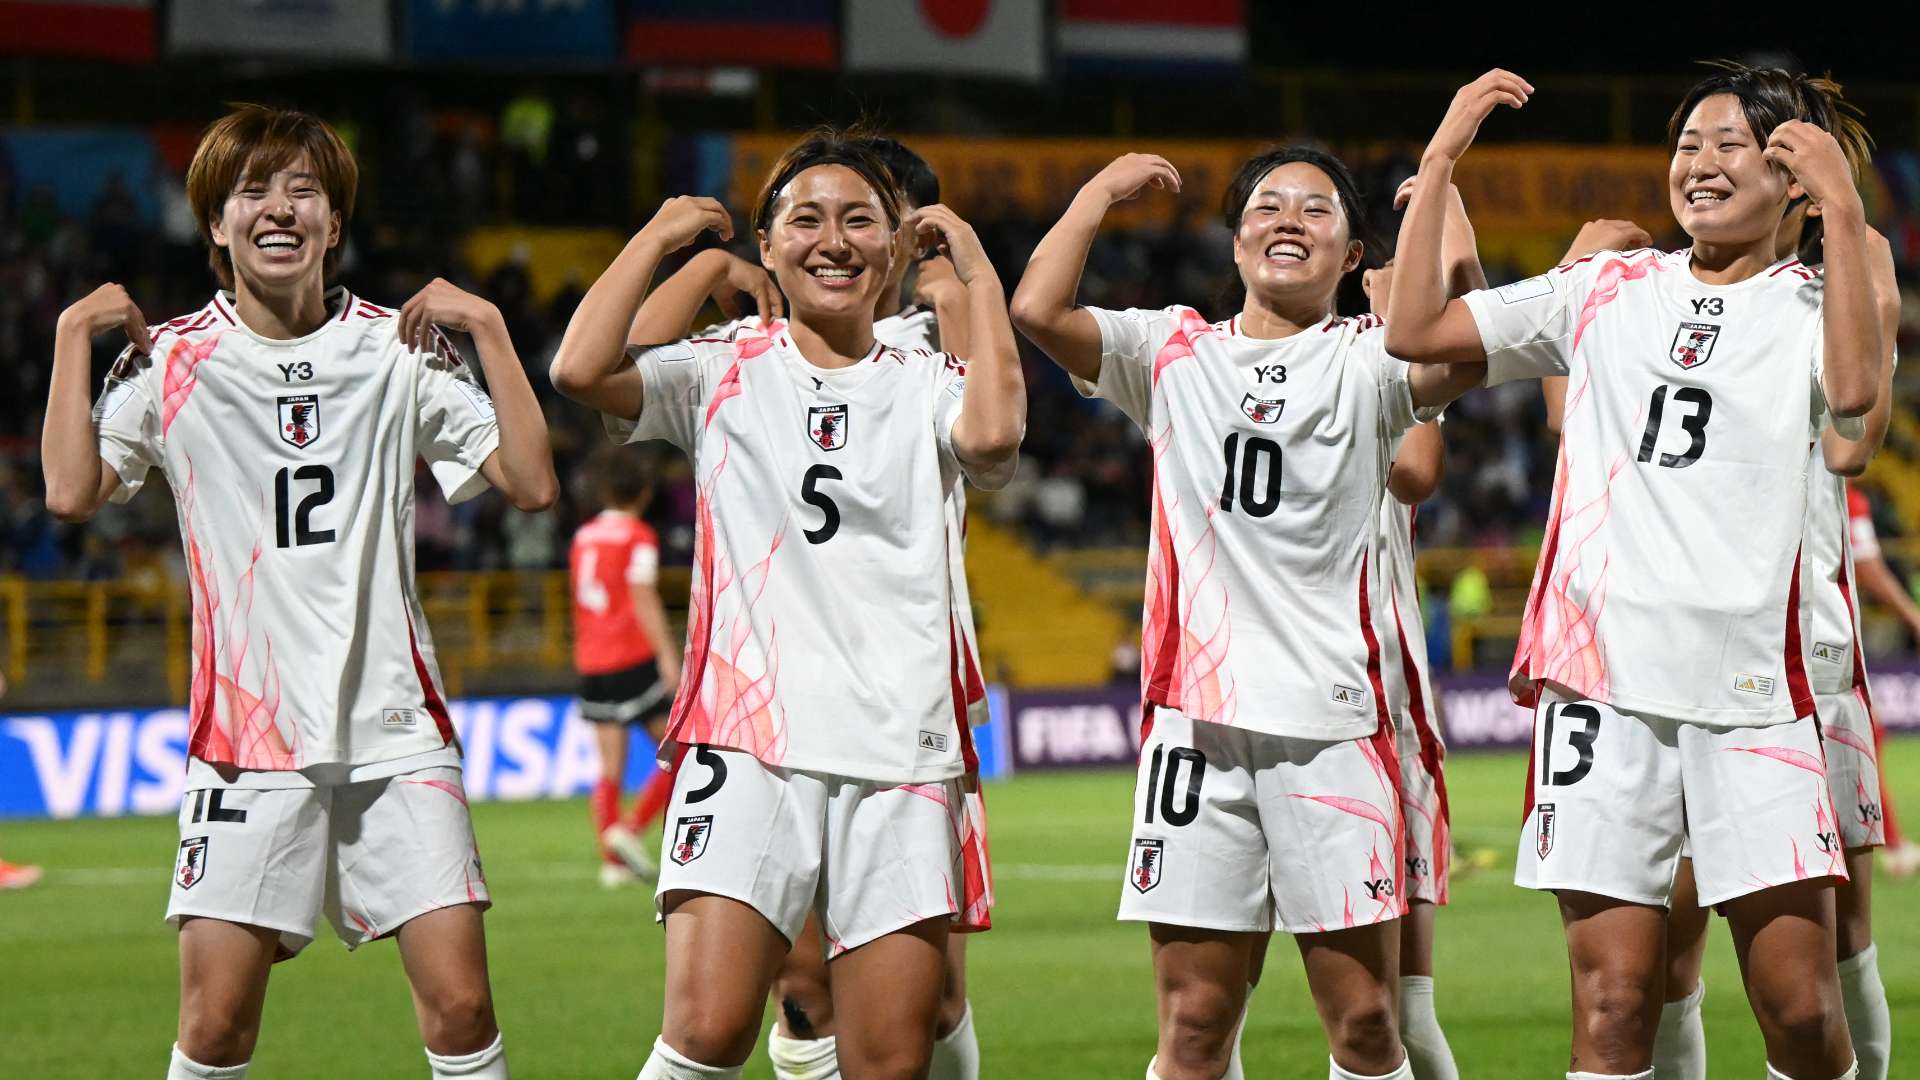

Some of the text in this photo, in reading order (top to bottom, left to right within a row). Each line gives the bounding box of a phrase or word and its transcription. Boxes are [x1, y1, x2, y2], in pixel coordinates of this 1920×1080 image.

[1691, 298, 1724, 315] Y-3
[277, 361, 314, 382] Y-3
[1254, 365, 1287, 383] Y-3
[1637, 384, 1712, 469] 13
[275, 465, 336, 548] 12
[801, 464, 843, 544] 5
[1220, 432, 1282, 518] 10
[8, 710, 190, 820] VIS
[450, 698, 604, 801] ISA
[1018, 704, 1128, 763] FIFA
[1542, 701, 1601, 786] 13
[685, 744, 728, 805] 5
[1145, 743, 1206, 827] 10
[1363, 878, 1394, 899] Y-3
